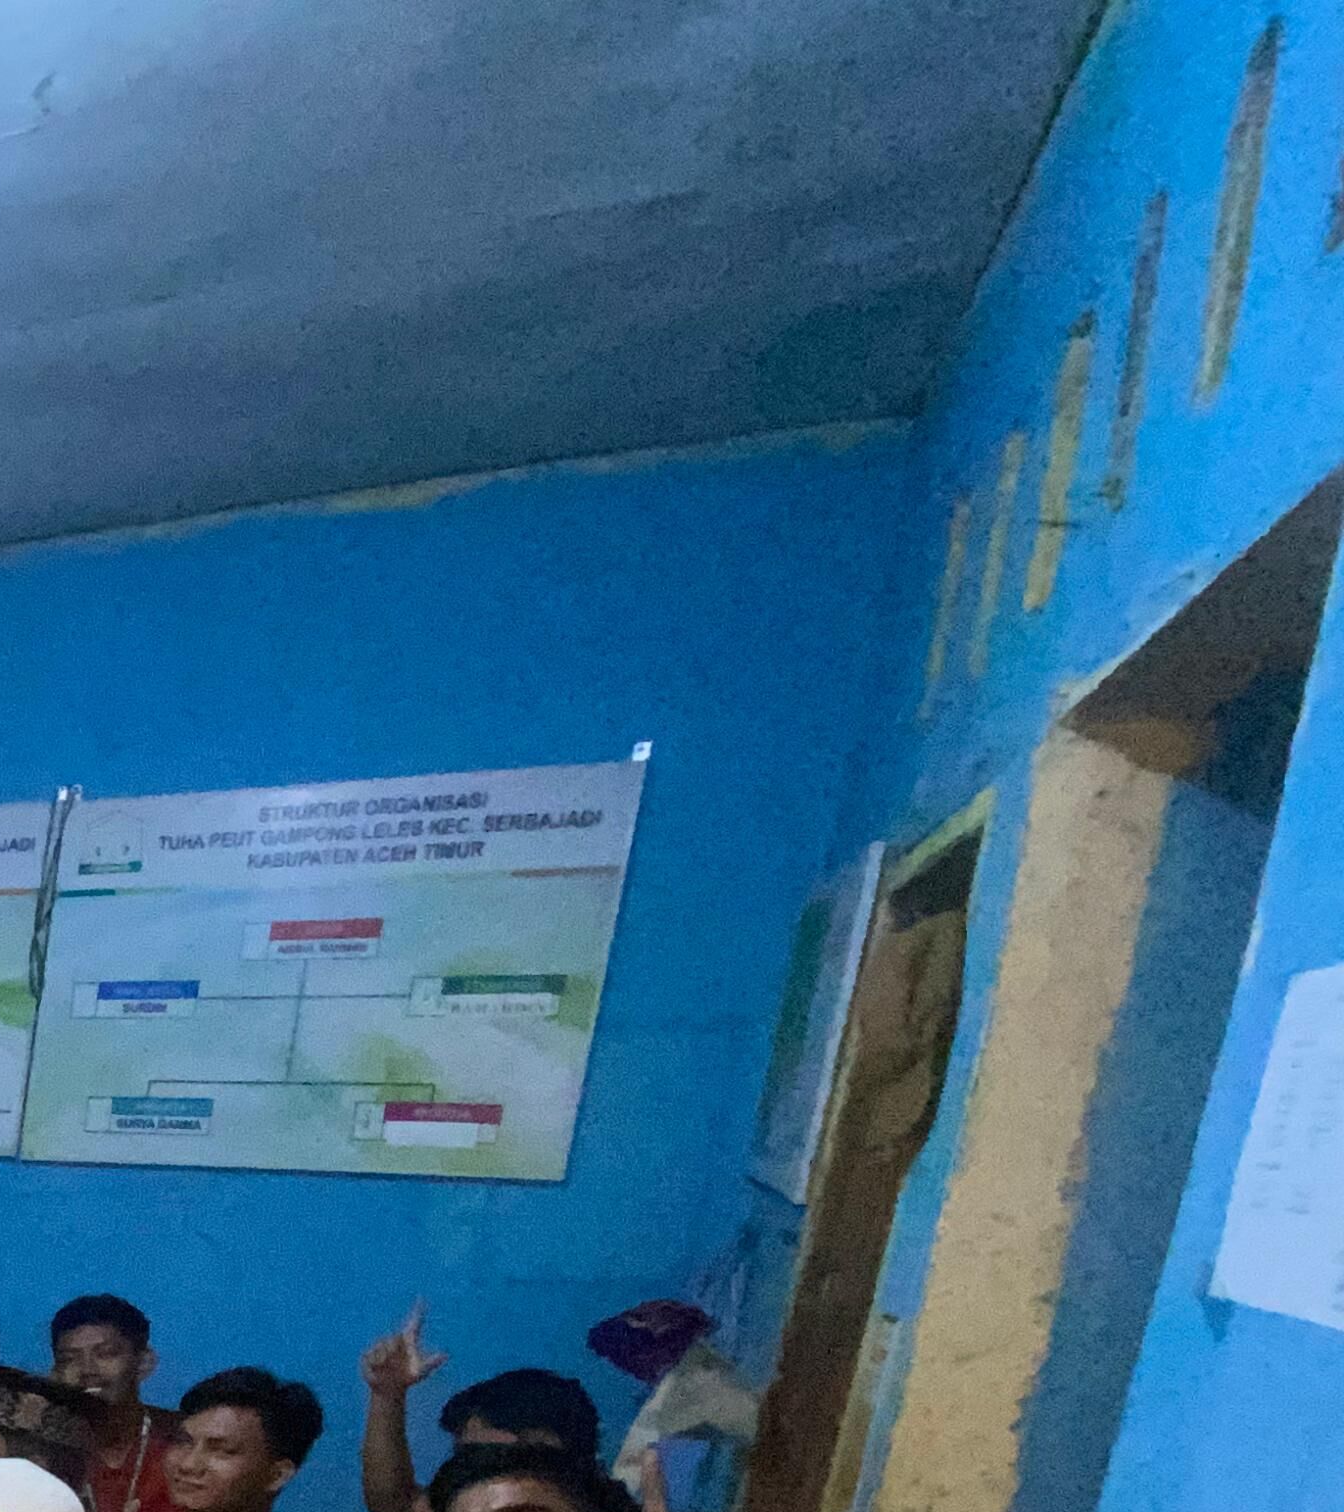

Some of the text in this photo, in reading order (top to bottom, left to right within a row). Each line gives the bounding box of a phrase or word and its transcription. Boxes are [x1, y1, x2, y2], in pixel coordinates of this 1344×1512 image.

[259, 792, 488, 823] STRUKTUR ORGANISASI
[209, 831, 256, 848] PEUT
[261, 825, 359, 846] GAMPONG
[361, 821, 423, 840] LELES
[484, 809, 603, 833] SERBAJADI
[247, 841, 485, 869] KABUPATEN ACEH TIMUR
